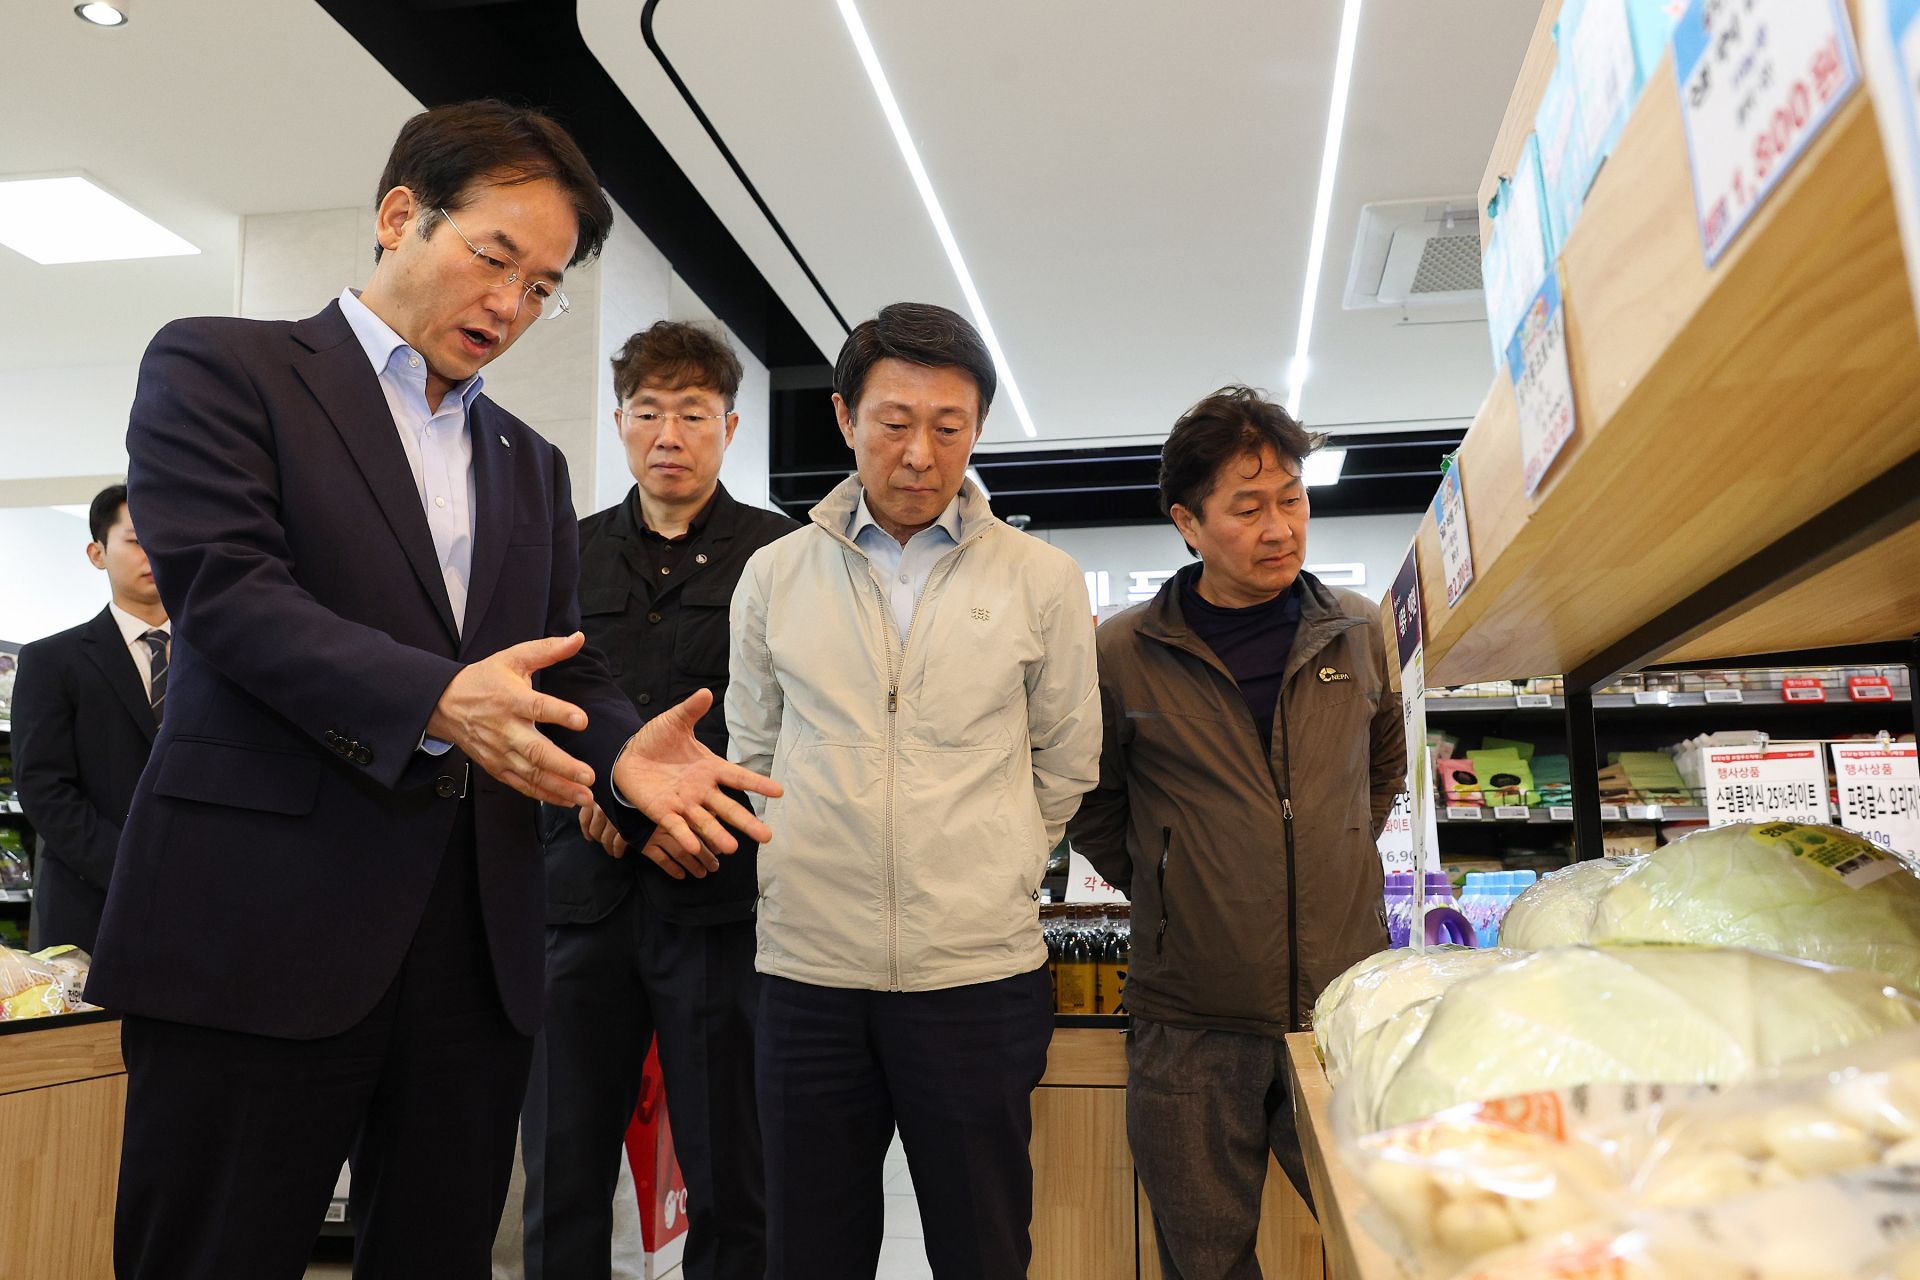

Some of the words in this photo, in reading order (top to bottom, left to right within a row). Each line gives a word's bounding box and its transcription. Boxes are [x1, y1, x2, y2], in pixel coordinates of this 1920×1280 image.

[1331, 673, 1350, 681] NEPA
[1717, 766, 1760, 780] 행사상품
[1844, 763, 1893, 776] 행사상품
[1847, 784, 1887, 820] 프링글스
[1889, 784, 1920, 820] 오리지
[1084, 876, 1098, 892] 각
